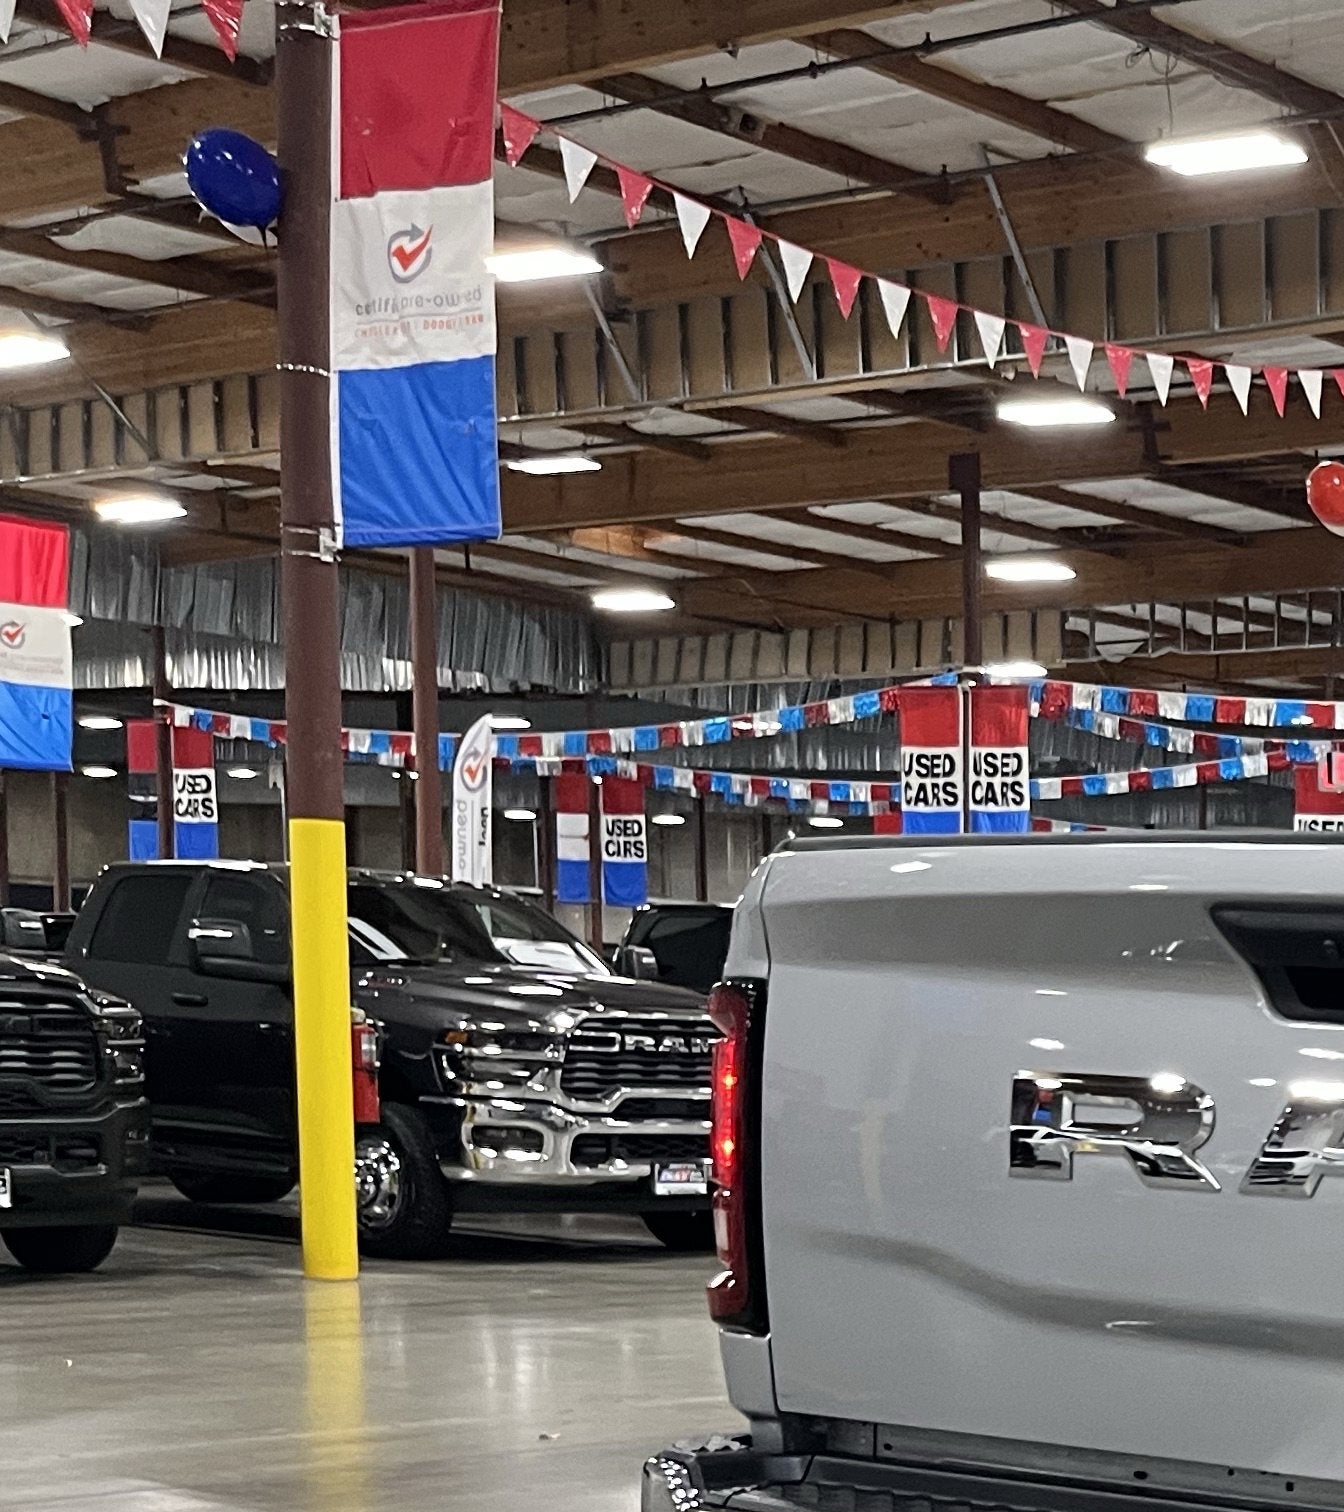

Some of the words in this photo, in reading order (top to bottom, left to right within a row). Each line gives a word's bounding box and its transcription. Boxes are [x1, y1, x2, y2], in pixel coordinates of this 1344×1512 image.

[903, 751, 956, 778] USED
[973, 750, 1023, 778] USED
[175, 773, 212, 794] USED
[904, 781, 959, 807] CARS
[971, 780, 1025, 807] CARS
[605, 818, 643, 837] USED
